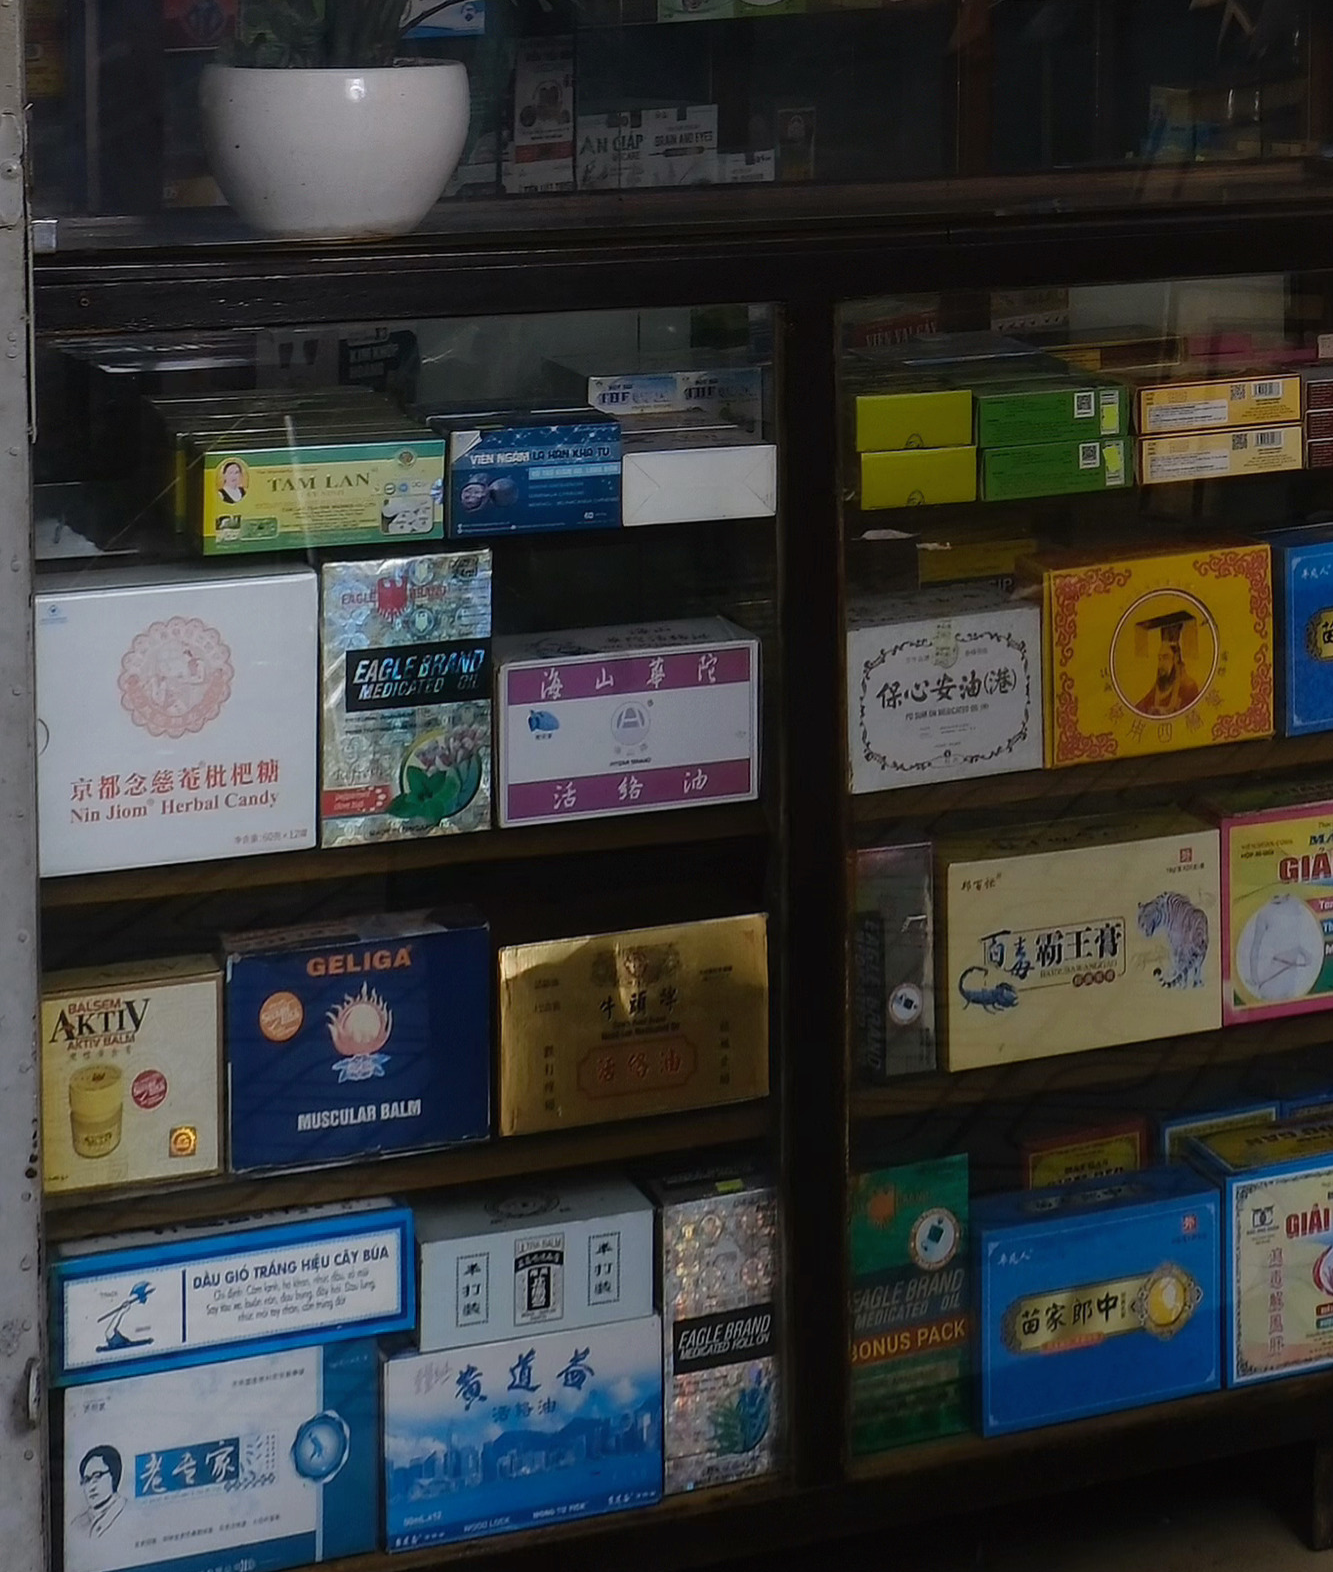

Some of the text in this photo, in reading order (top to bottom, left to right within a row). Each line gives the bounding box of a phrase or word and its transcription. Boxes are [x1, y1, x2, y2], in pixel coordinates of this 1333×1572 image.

[326, 471, 371, 489] LAN
[352, 648, 486, 686] EAGLE BRAND
[357, 672, 479, 702] MEDICATED OIL
[69, 806, 101, 825] Nin
[160, 794, 220, 816] Herbal
[224, 789, 280, 811] Candy
[306, 945, 413, 977] GELIGA
[49, 997, 152, 1044] AKTIV
[68, 998, 122, 1015] BALSEM
[67, 1034, 135, 1052] AKTIV BALM
[296, 1098, 422, 1131] MUSCULAR BALM
[1285, 1202, 1331, 1240] GIẢI
[225, 1262, 250, 1285] GIÓ
[333, 1248, 358, 1267] CÂY
[363, 1244, 389, 1260] BÚA
[905, 1268, 966, 1300] BRAND
[855, 1291, 961, 1331] MEDICATED OIL
[1020, 1291, 1120, 1336] 苗家郎中
[678, 1313, 772, 1351] EAGLE BRAND
[917, 1319, 966, 1348] PACK
[489, 1516, 511, 1530] LOCK
